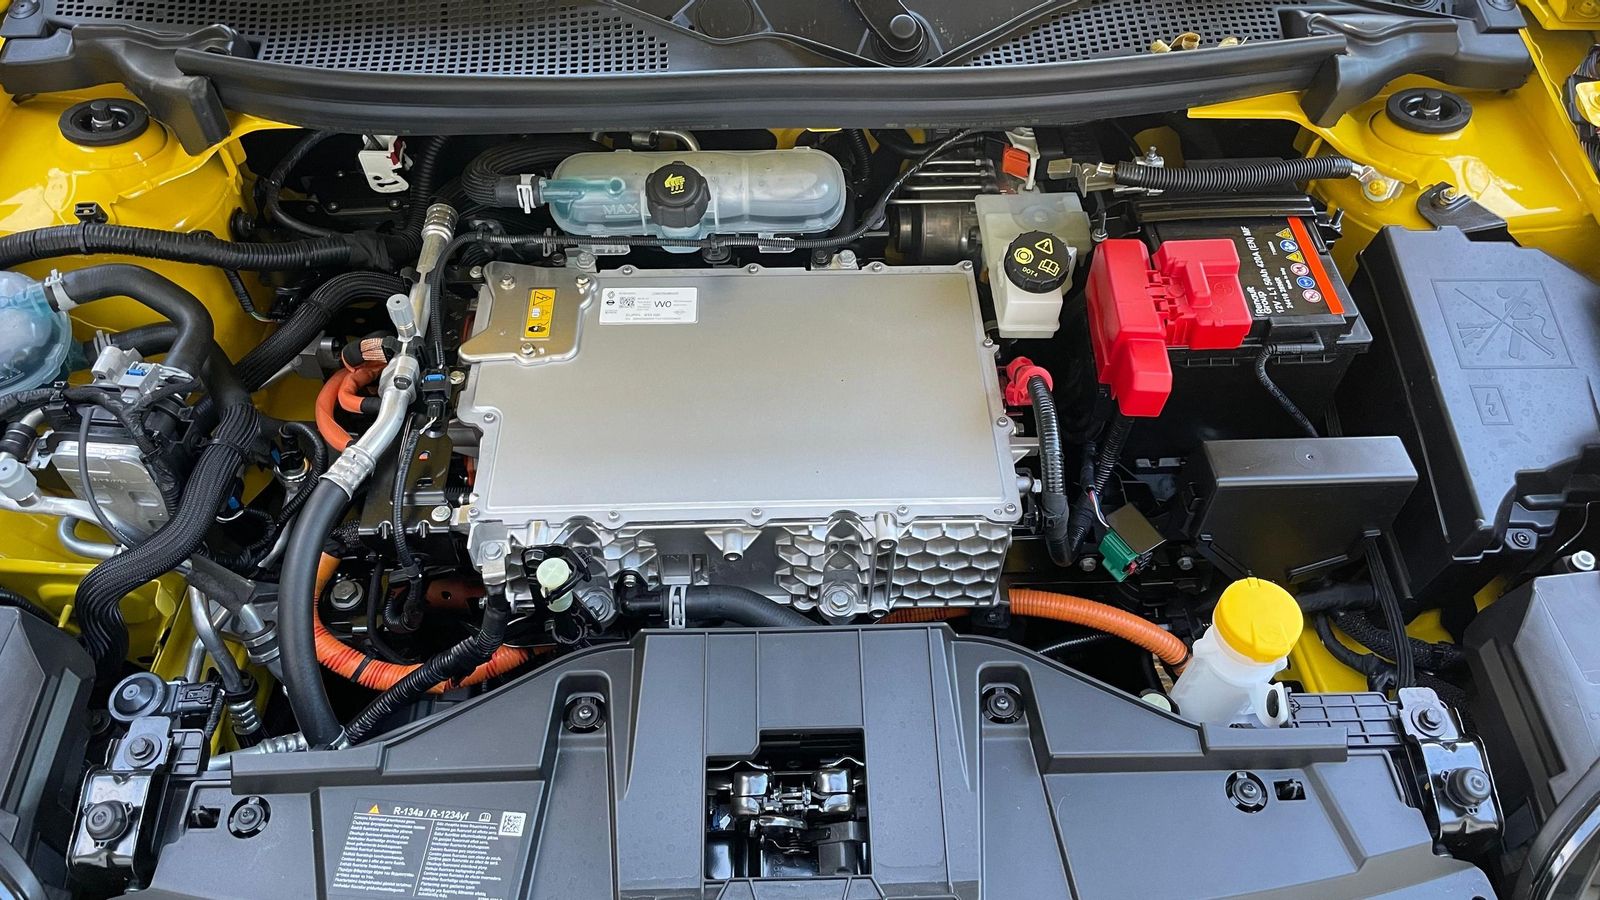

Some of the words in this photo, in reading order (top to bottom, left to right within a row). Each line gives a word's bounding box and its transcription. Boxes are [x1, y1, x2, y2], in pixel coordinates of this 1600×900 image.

[602, 203, 639, 215] MAX
[1245, 236, 1259, 251] (EN)
[1246, 286, 1264, 314] Renault
[1257, 291, 1272, 314] Group
[1272, 300, 1285, 313] 12V
[393, 806, 424, 817] R-134a
[430, 809, 470, 821] R-1234yf
